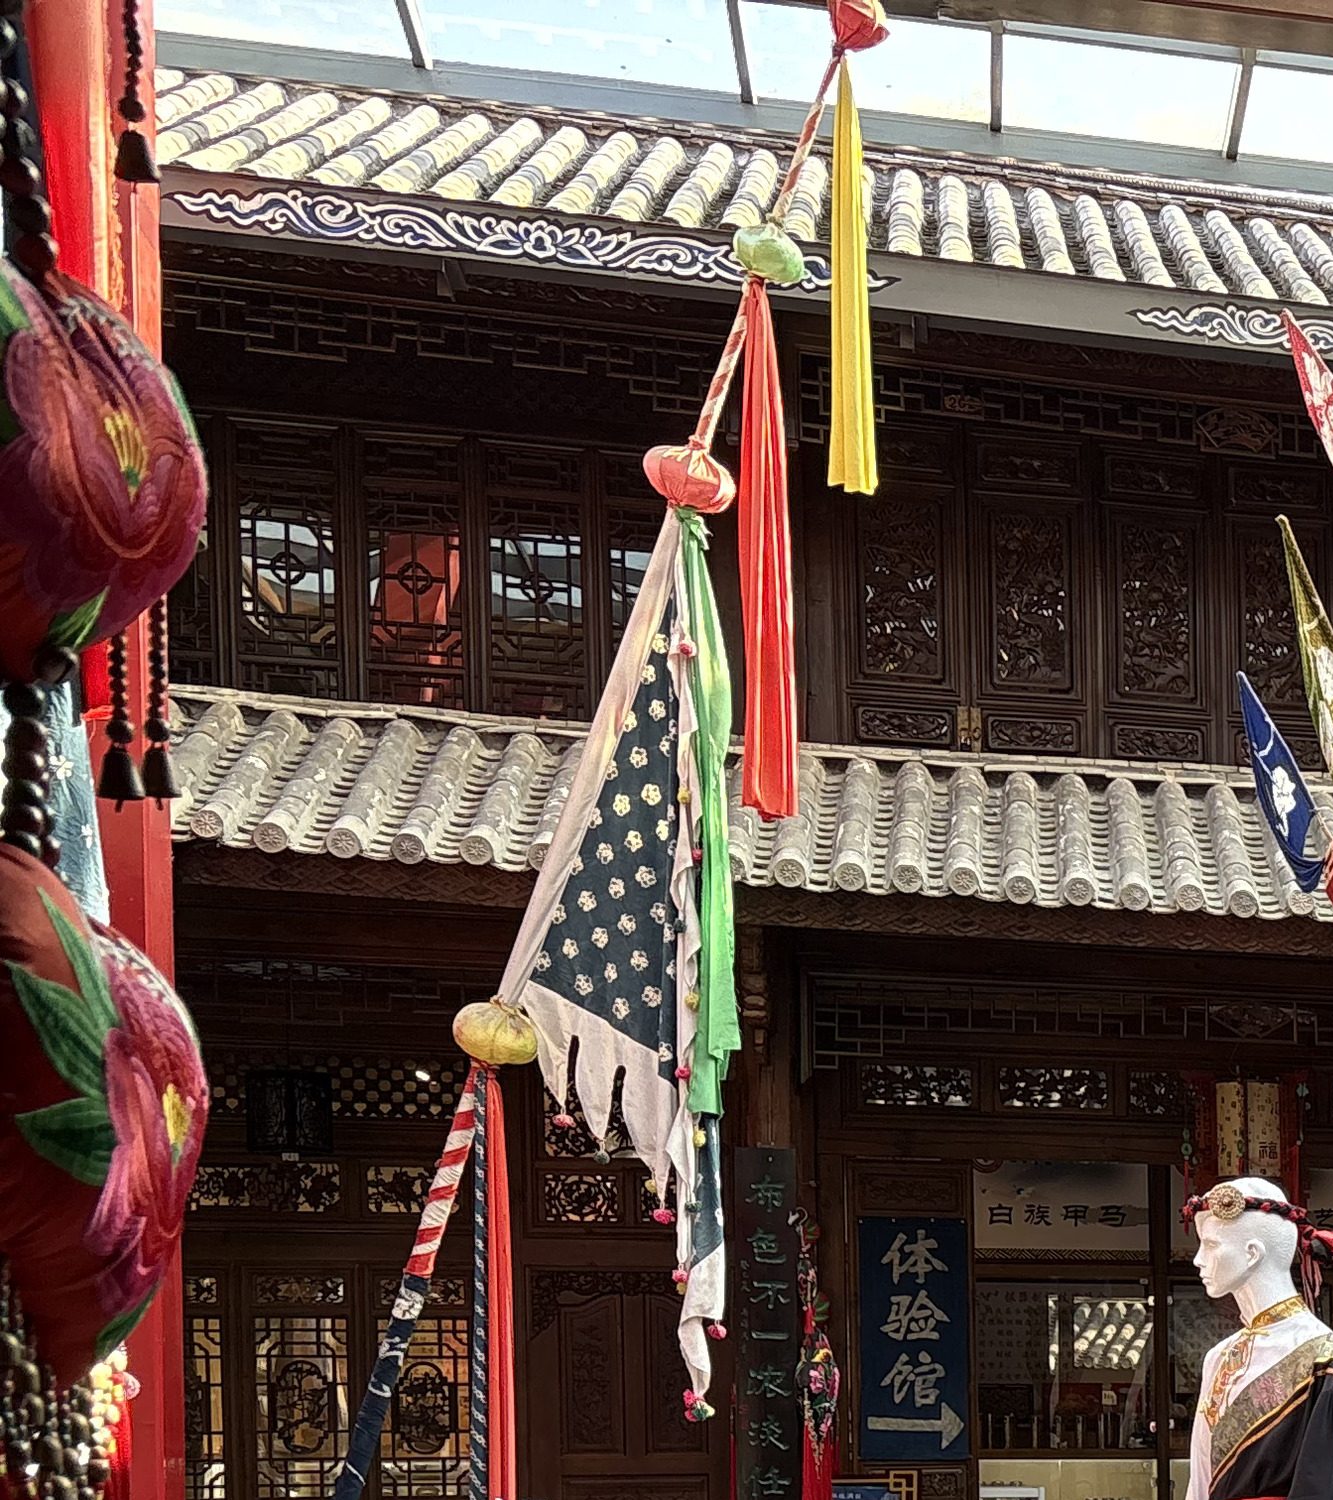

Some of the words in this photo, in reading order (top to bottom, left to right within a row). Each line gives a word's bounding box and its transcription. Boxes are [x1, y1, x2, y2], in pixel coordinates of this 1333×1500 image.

[988, 1203, 1127, 1228] 白族甲马
[880, 1230, 951, 1408] 体验馆
